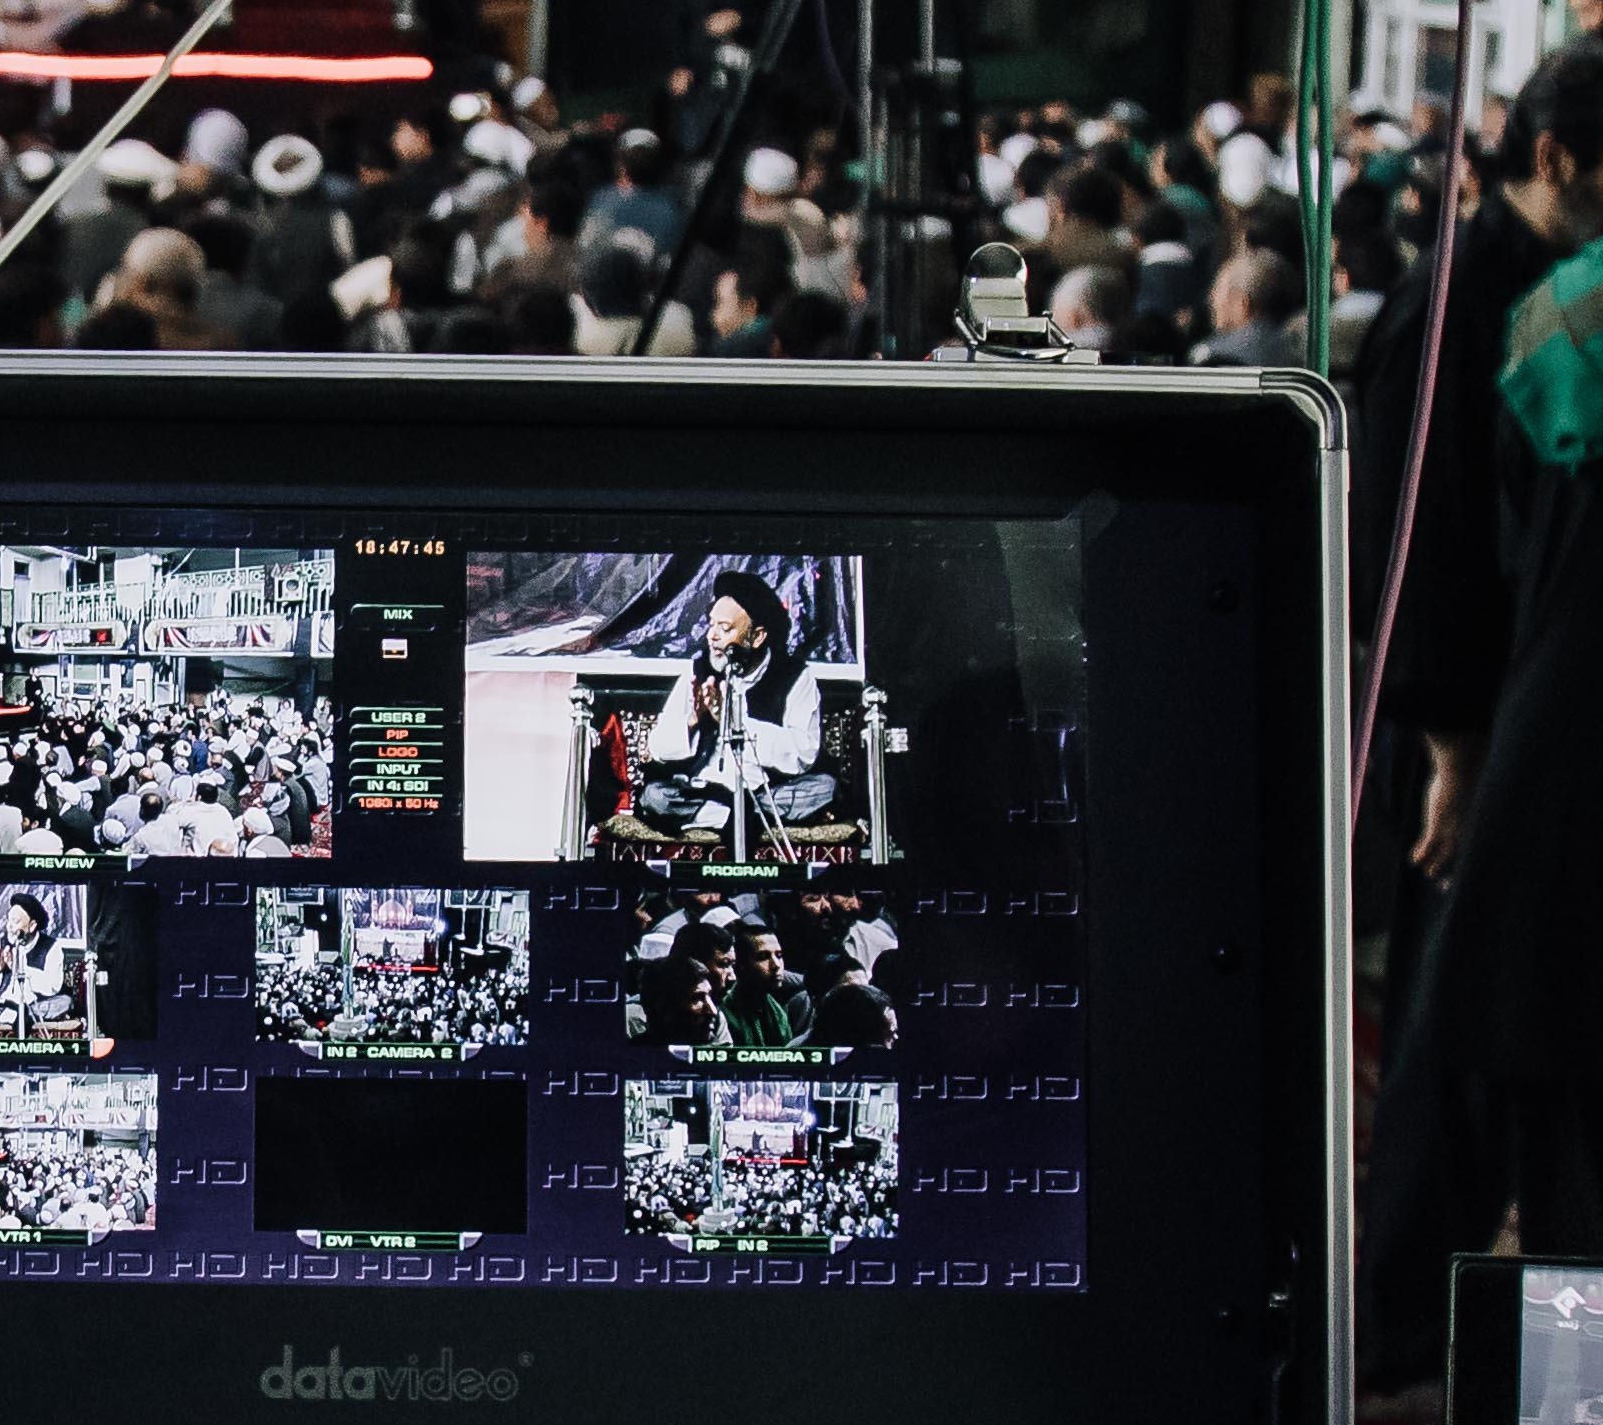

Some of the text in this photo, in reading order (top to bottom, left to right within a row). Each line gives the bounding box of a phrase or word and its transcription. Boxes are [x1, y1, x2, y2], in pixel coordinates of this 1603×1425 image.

[355, 540, 445, 555] 18:47:45
[383, 609, 413, 620] MIX
[371, 712, 426, 724] USER 2
[386, 729, 409, 740] PIP
[378, 747, 419, 758] LOGO
[376, 764, 421, 775] INPUT
[367, 781, 384, 791] IN
[403, 781, 429, 792] SDI
[424, 799, 439, 809] Hz
[24, 857, 95, 870] PREVIEW
[702, 865, 779, 877] PROGRAM
[71, 1044, 80, 1055] 1
[327, 1046, 453, 1059] IN 2 CAMERA 2
[697, 1050, 823, 1063] IN 3 CAMERA 3
[33, 1231, 42, 1243] 1
[325, 1236, 417, 1249] DVI VTR 2
[696, 1239, 769, 1252] PIP IN 2
[261, 1249, 338, 1278] HD
[634, 1255, 711, 1284] HD
[1005, 1259, 1082, 1288] HD
[260, 1345, 519, 1402] datavideo
